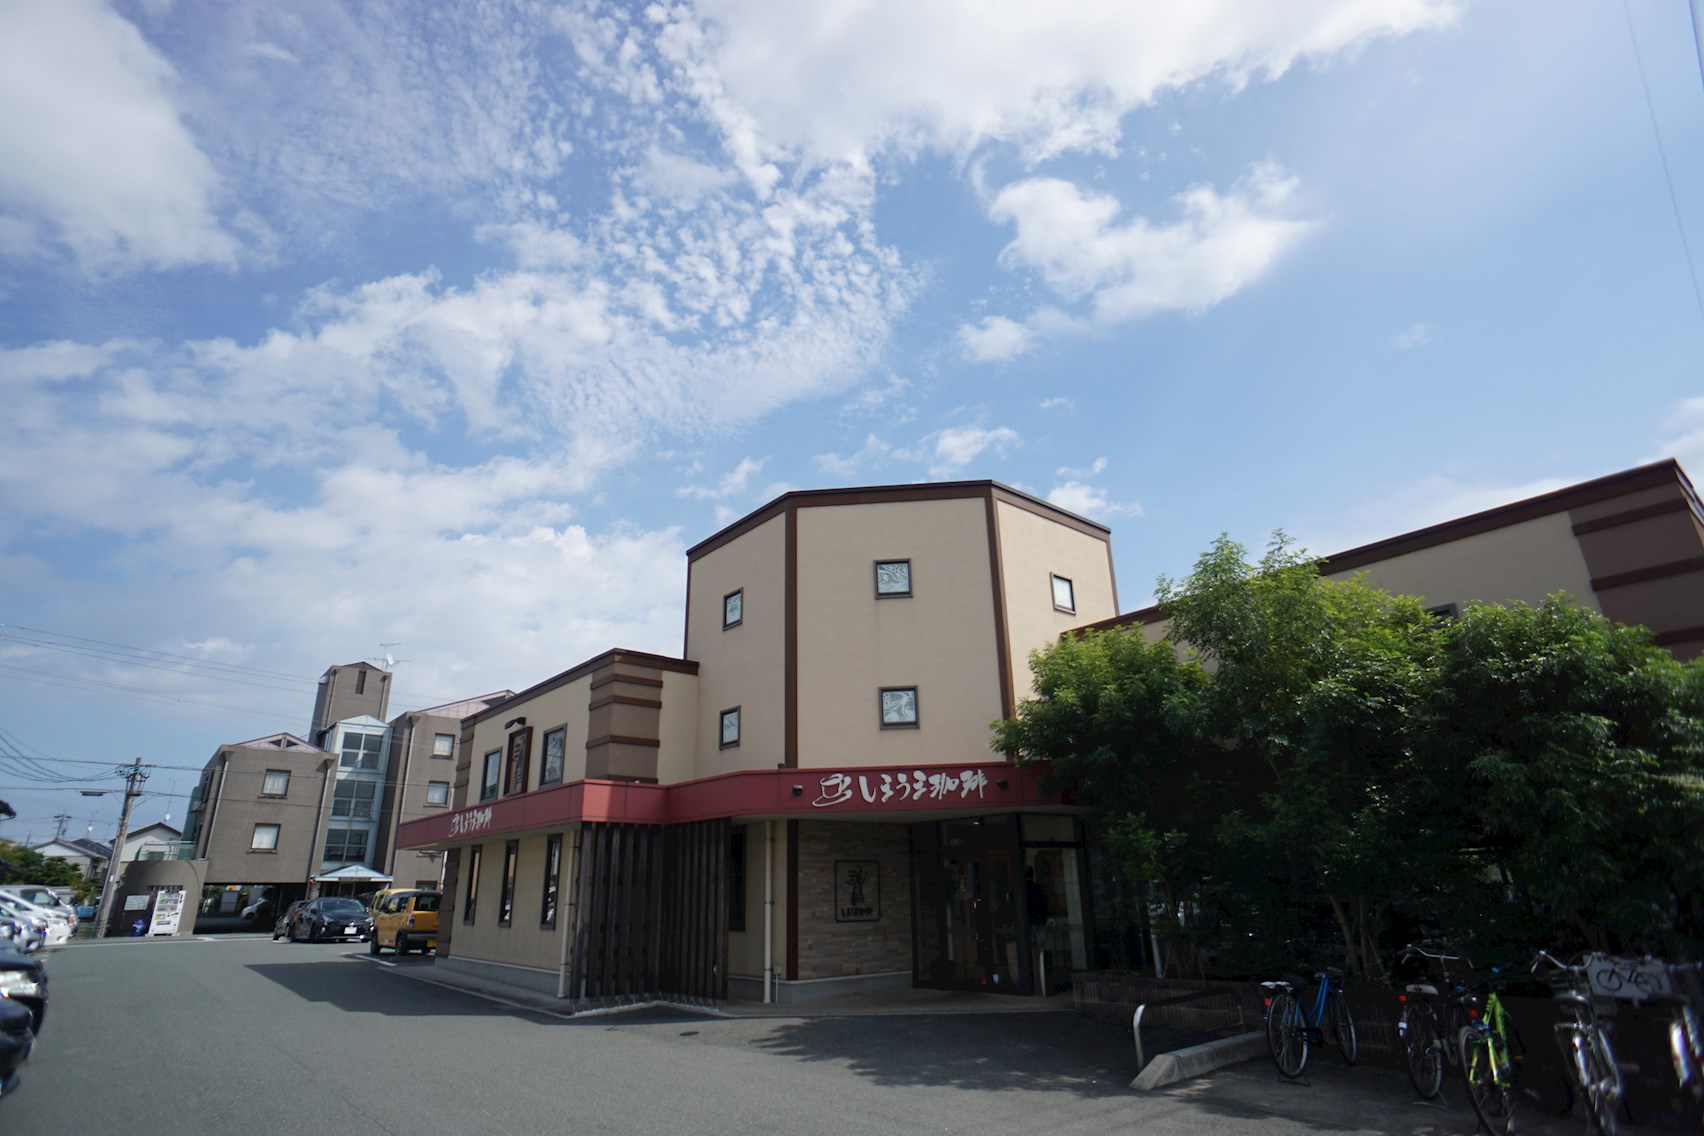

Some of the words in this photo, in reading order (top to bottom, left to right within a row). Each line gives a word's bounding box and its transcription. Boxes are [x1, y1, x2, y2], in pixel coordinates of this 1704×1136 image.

[858, 768, 988, 803] しまうま珈琲
